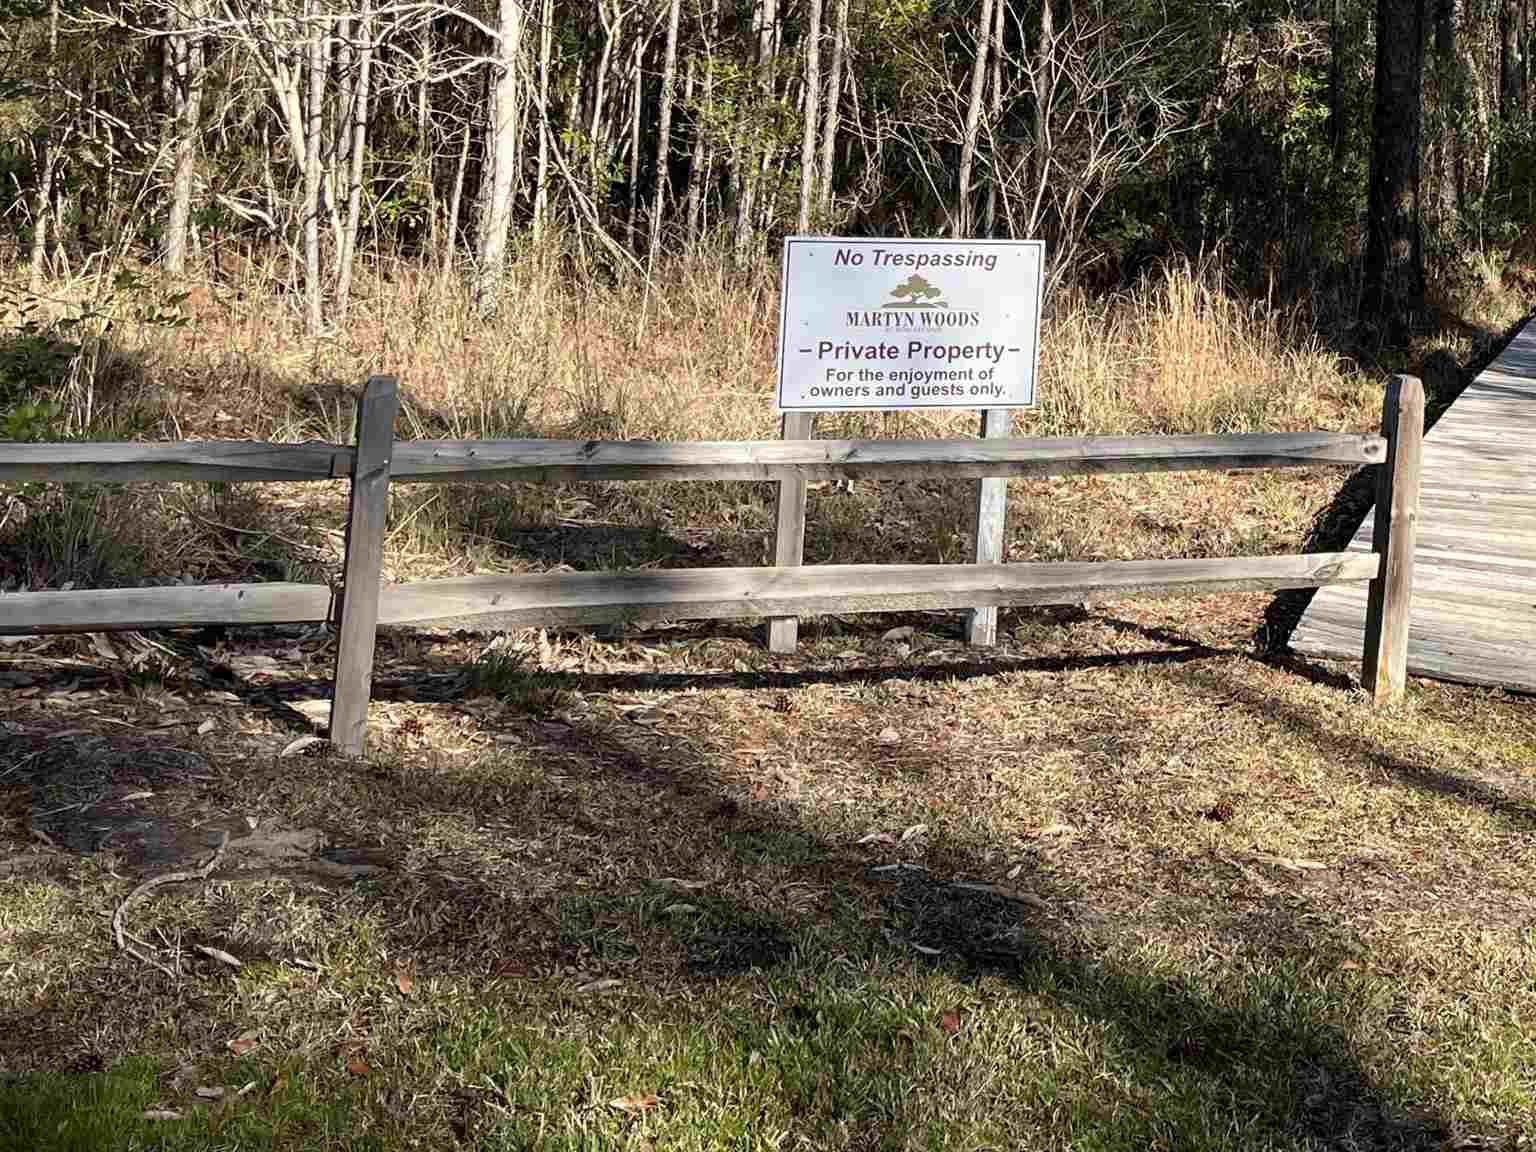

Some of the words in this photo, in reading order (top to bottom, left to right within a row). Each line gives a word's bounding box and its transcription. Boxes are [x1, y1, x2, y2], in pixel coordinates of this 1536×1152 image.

[834, 249, 864, 266] No
[872, 250, 998, 271] Trespassing
[846, 311, 916, 327] MARTYN
[920, 311, 980, 327] WOODS
[818, 341, 899, 360] Private
[907, 341, 1005, 364] Property
[826, 368, 854, 382] For
[857, 368, 884, 382] the
[889, 368, 974, 385] enjoyment
[978, 367, 995, 381] of
[810, 383, 870, 397] owners
[875, 382, 905, 396] and
[911, 382, 965, 399] guests
[969, 381, 1006, 397] only.
